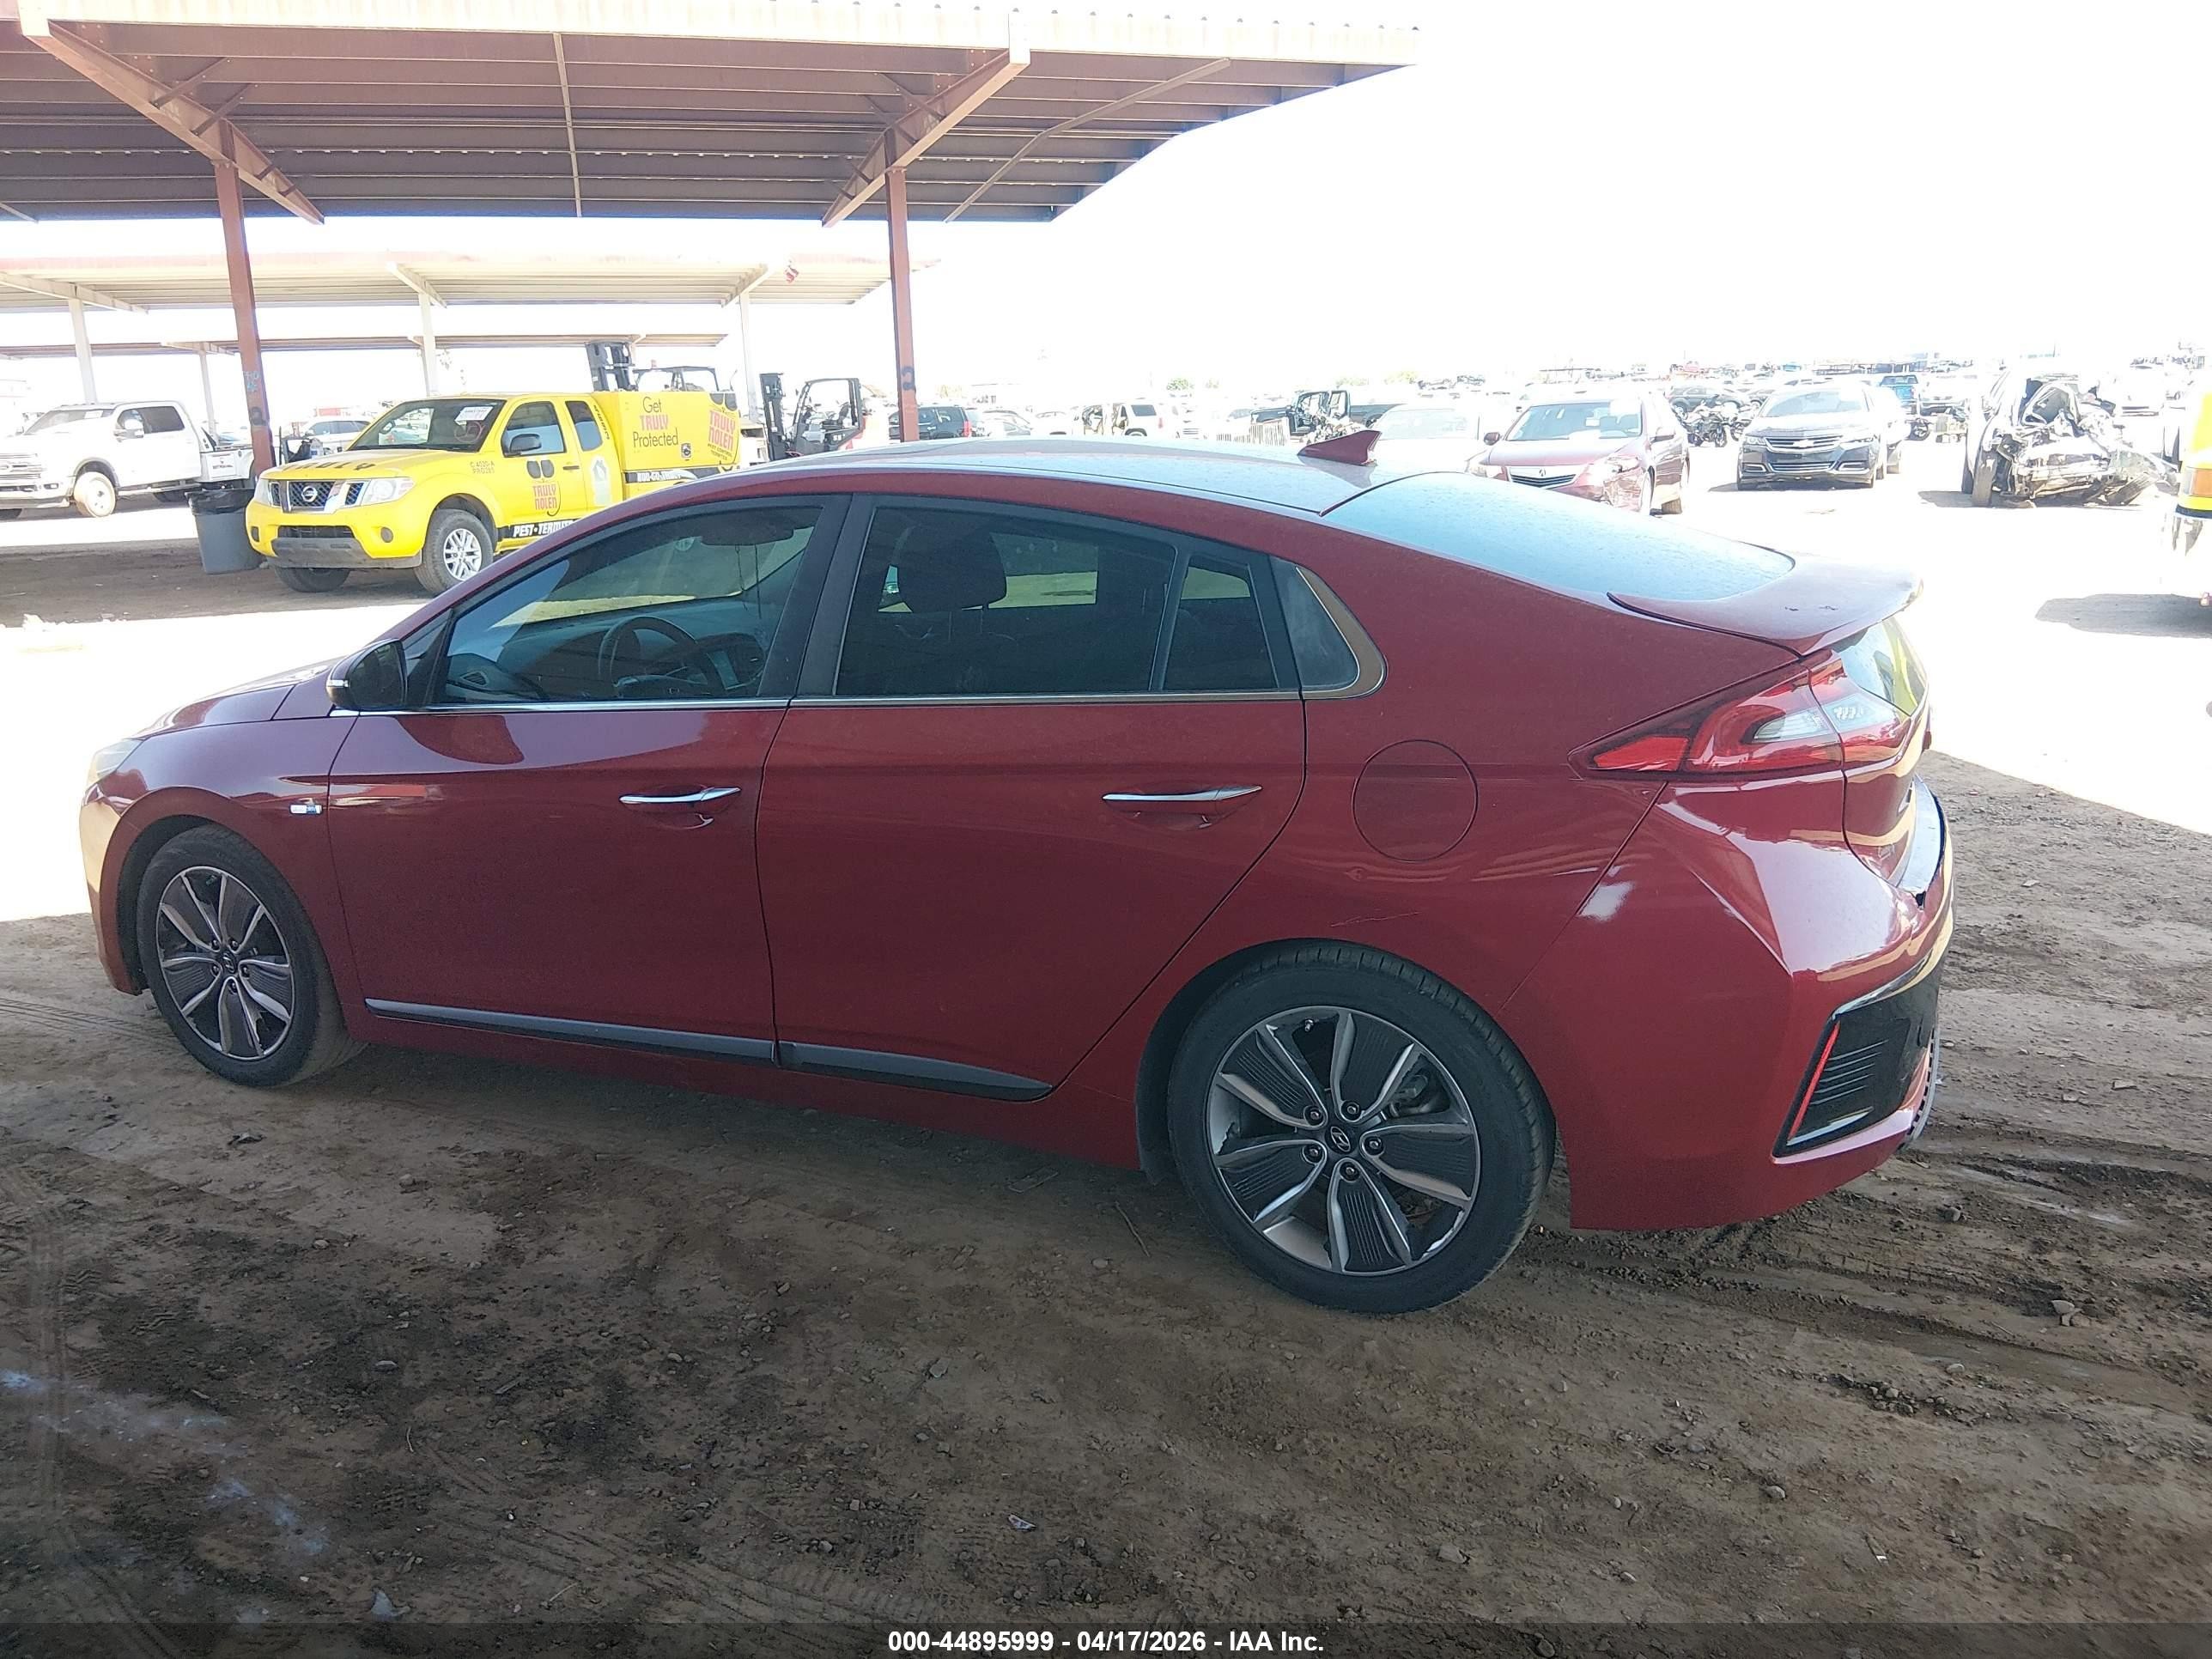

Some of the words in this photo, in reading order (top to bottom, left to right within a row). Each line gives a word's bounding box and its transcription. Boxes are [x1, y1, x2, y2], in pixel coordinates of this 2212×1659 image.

[642, 396, 661, 413] Get
[639, 414, 669, 430] TRULY
[709, 410, 736, 434] TRULY
[633, 428, 679, 447] Protected
[708, 425, 734, 452] NOLEN
[532, 484, 556, 497] TRULY
[534, 497, 558, 511] NOLEN
[513, 524, 534, 538] PEST
